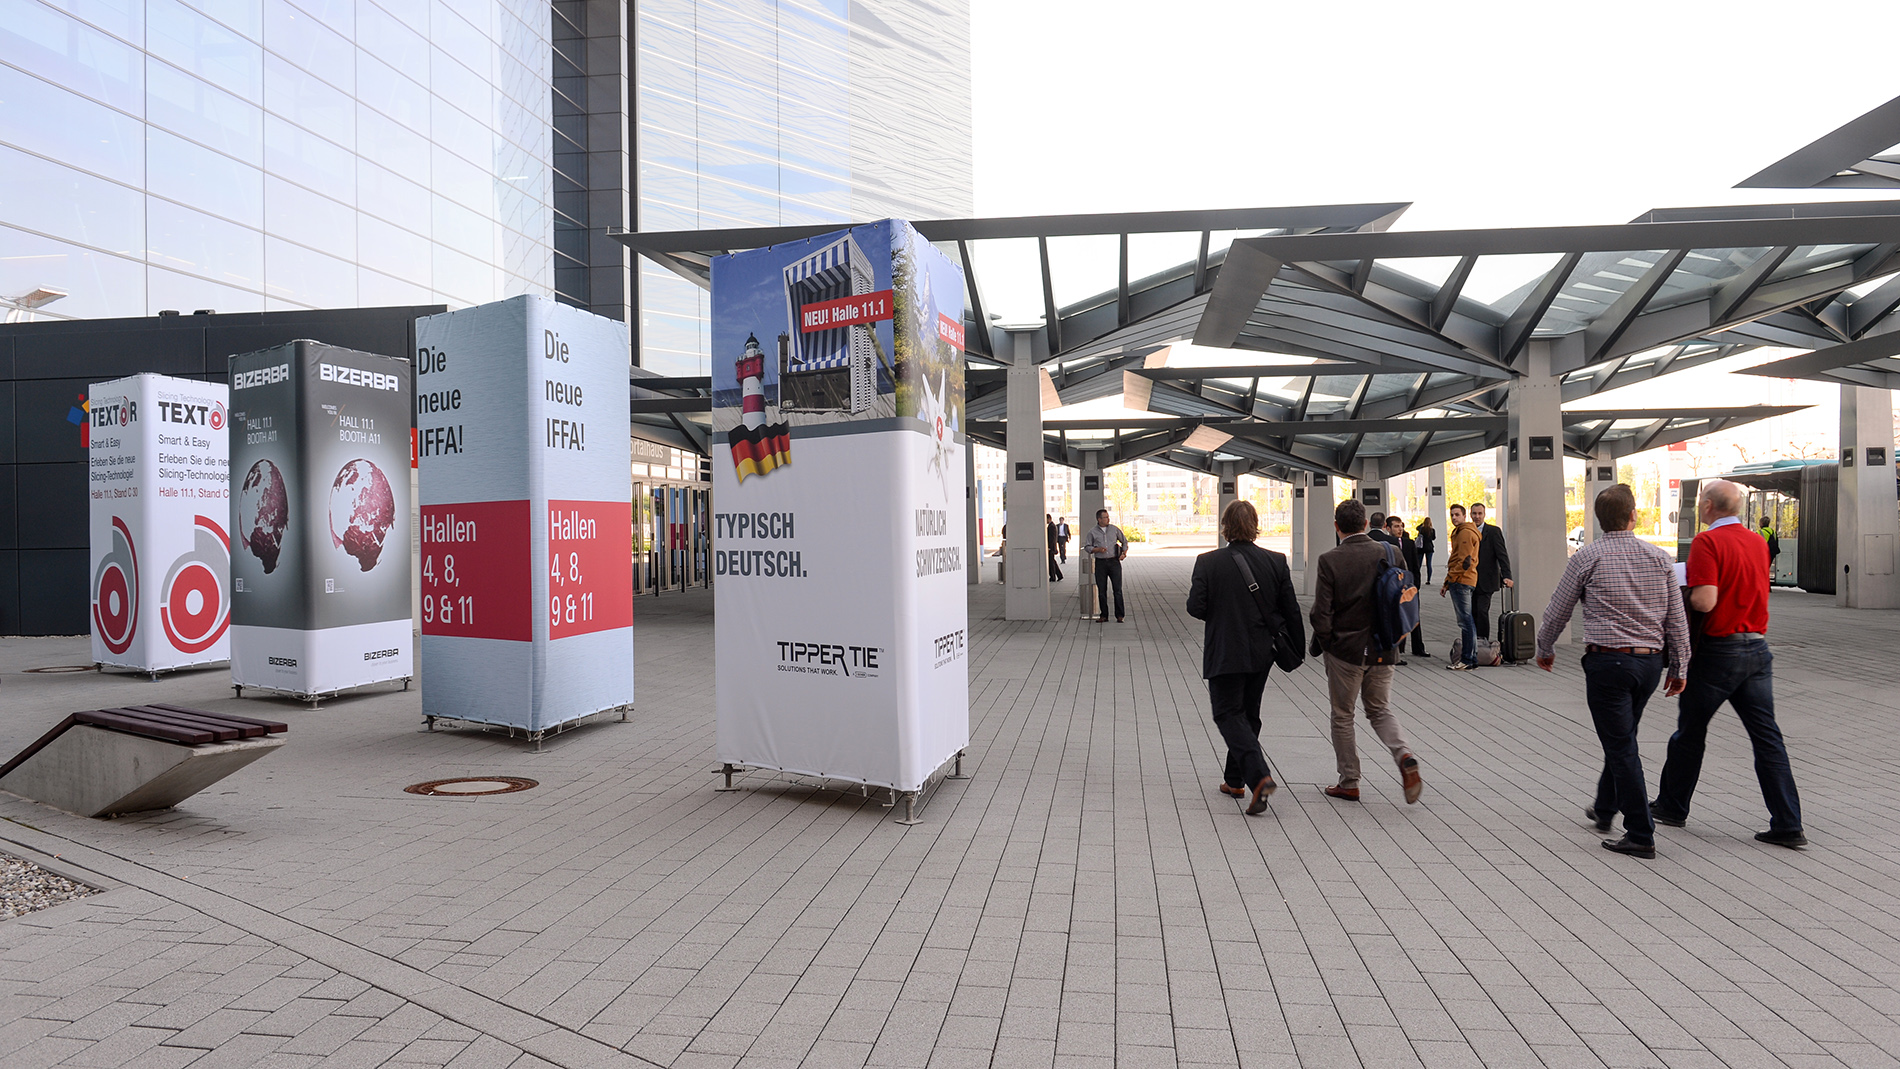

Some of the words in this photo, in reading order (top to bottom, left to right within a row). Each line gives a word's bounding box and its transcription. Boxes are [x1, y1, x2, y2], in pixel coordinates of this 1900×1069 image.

[804, 308, 829, 327] NEU!
[832, 305, 859, 323] Halle
[861, 299, 884, 317] 11.1
[544, 329, 569, 364] Die
[419, 346, 446, 375] Die
[234, 363, 289, 391] BIZERBA
[319, 363, 399, 392] BIZERBA
[158, 391, 179, 402] Slicing
[180, 393, 214, 406] Technology
[419, 389, 461, 414] neue
[545, 379, 583, 407] neue
[158, 400, 229, 430] TEXTO
[247, 418, 261, 430] HALL
[262, 416, 272, 428] 11.1
[339, 415, 359, 429] HALL
[361, 418, 374, 430] 11.1
[91, 439, 105, 449] Smart
[105, 438, 110, 448] &
[110, 437, 121, 449] Easy
[158, 433, 182, 446] Smart
[184, 436, 190, 446] &
[192, 437, 210, 450] Easy
[247, 431, 267, 445] BOOTH
[268, 430, 278, 442] A11
[339, 429, 367, 444] BOOTH
[368, 432, 381, 445] A11
[419, 425, 463, 457] IFFA!
[546, 418, 585, 451] IFFA!
[91, 457, 109, 467] Erleben
[116, 455, 124, 465] die
[125, 455, 136, 464] neue
[158, 452, 188, 464] Erleben
[190, 454, 202, 465] Sie
[204, 456, 216, 466] die
[630, 438, 664, 459] ortalhaus
[91, 468, 134, 484] Slicing-Technologie!
[91, 489, 103, 499] Halle
[113, 488, 127, 499] Stand
[128, 487, 132, 497] C
[132, 487, 139, 497] 30
[158, 487, 178, 498] Halle
[181, 488, 196, 499] 11.1,
[198, 488, 221, 498] Stand
[223, 488, 230, 499] C
[423, 513, 477, 543] Hallen
[551, 510, 596, 540] Hallen
[715, 512, 794, 539] TYPISCH
[915, 503, 947, 537] NATÜRLICH
[423, 555, 438, 587] 4,
[444, 554, 460, 587] 8,
[551, 553, 565, 587] 4,
[569, 552, 583, 585] 8,
[715, 550, 808, 578] DEUTSCH.
[916, 546, 962, 578] SCHWYZERISCH.
[424, 595, 434, 623] 9
[440, 595, 453, 624] &
[458, 596, 473, 625] 11
[551, 596, 561, 627] 9
[565, 594, 577, 624] &
[580, 592, 593, 621] 11
[268, 656, 298, 668] BIZERBA
[364, 648, 399, 661] BIZERBA
[777, 664, 806, 673] SOLUTIONS
[807, 667, 820, 675] THAT
[820, 668, 838, 676] WORK.
